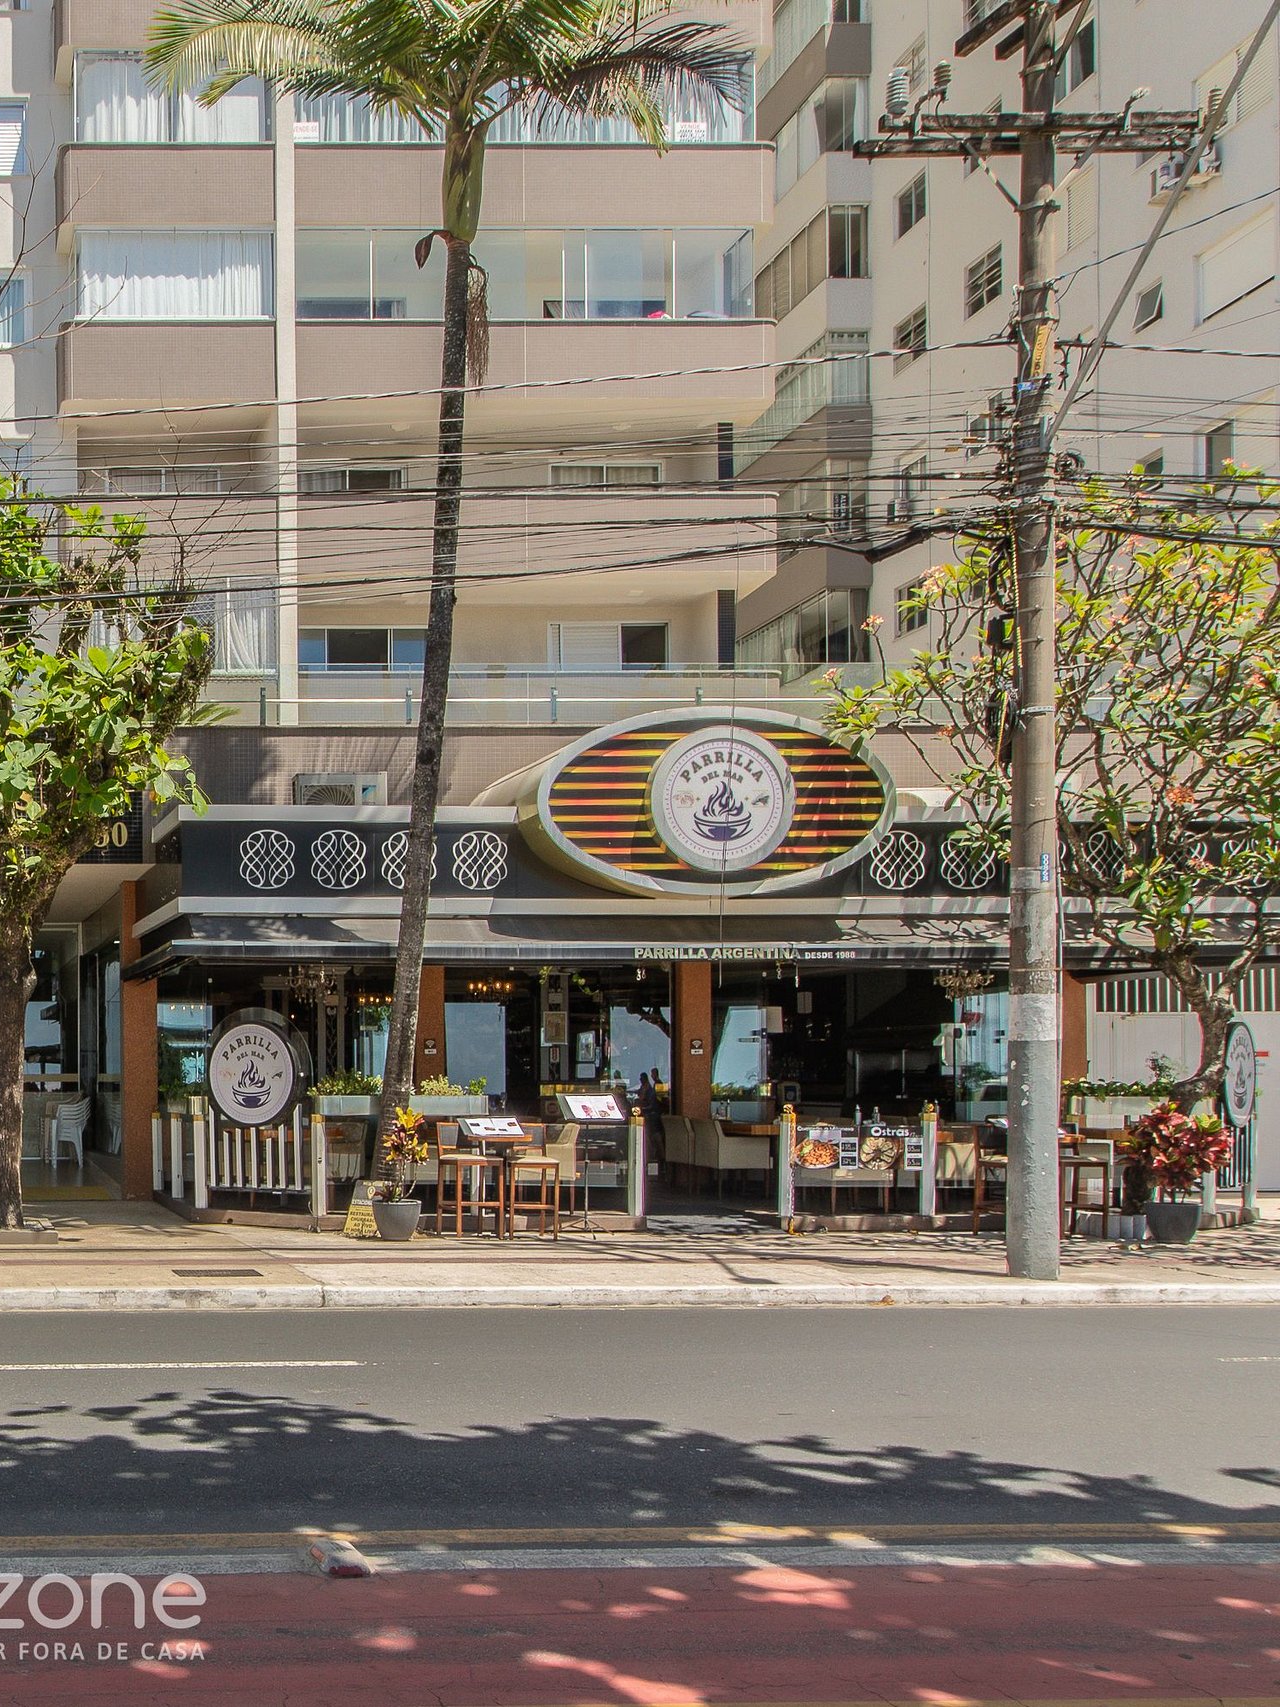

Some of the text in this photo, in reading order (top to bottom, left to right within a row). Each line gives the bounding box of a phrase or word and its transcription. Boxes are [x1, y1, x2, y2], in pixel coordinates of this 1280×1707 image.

[680, 751, 763, 783] PARRILLA
[701, 770, 743, 784] DEL MAR
[634, 947, 708, 959] PARRILLA
[711, 947, 801, 959] ARGENTINA
[805, 951, 833, 959] DESDE
[222, 1035, 278, 1061] PARRILLA
[871, 1126, 909, 1137] Ostras
